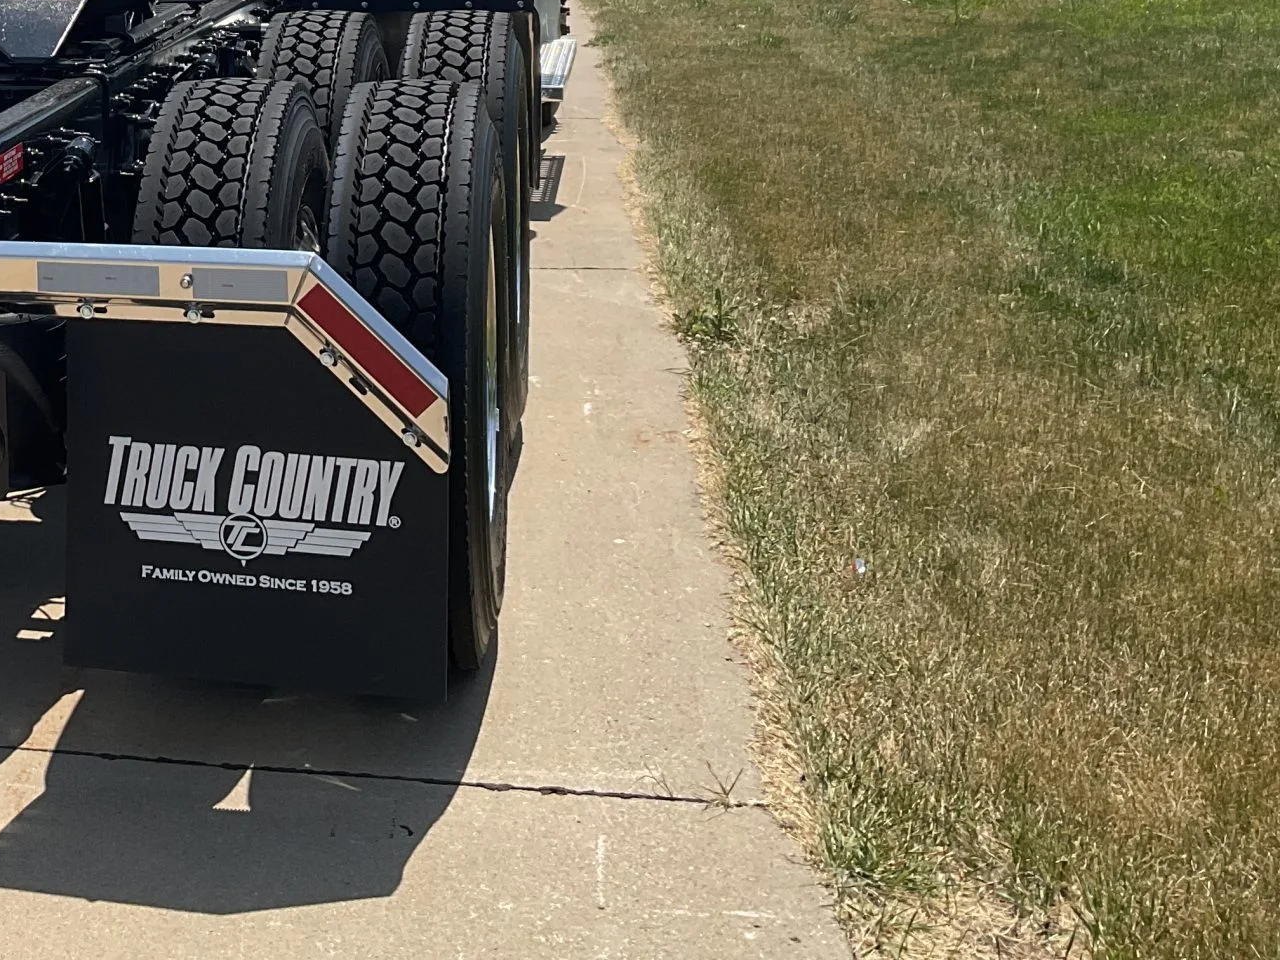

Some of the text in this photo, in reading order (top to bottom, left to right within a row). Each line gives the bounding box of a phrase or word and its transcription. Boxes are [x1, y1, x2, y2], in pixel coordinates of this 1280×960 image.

[104, 435, 225, 513] TRUCK
[141, 565, 353, 596] FAMILY OWNED SINCE 1958
